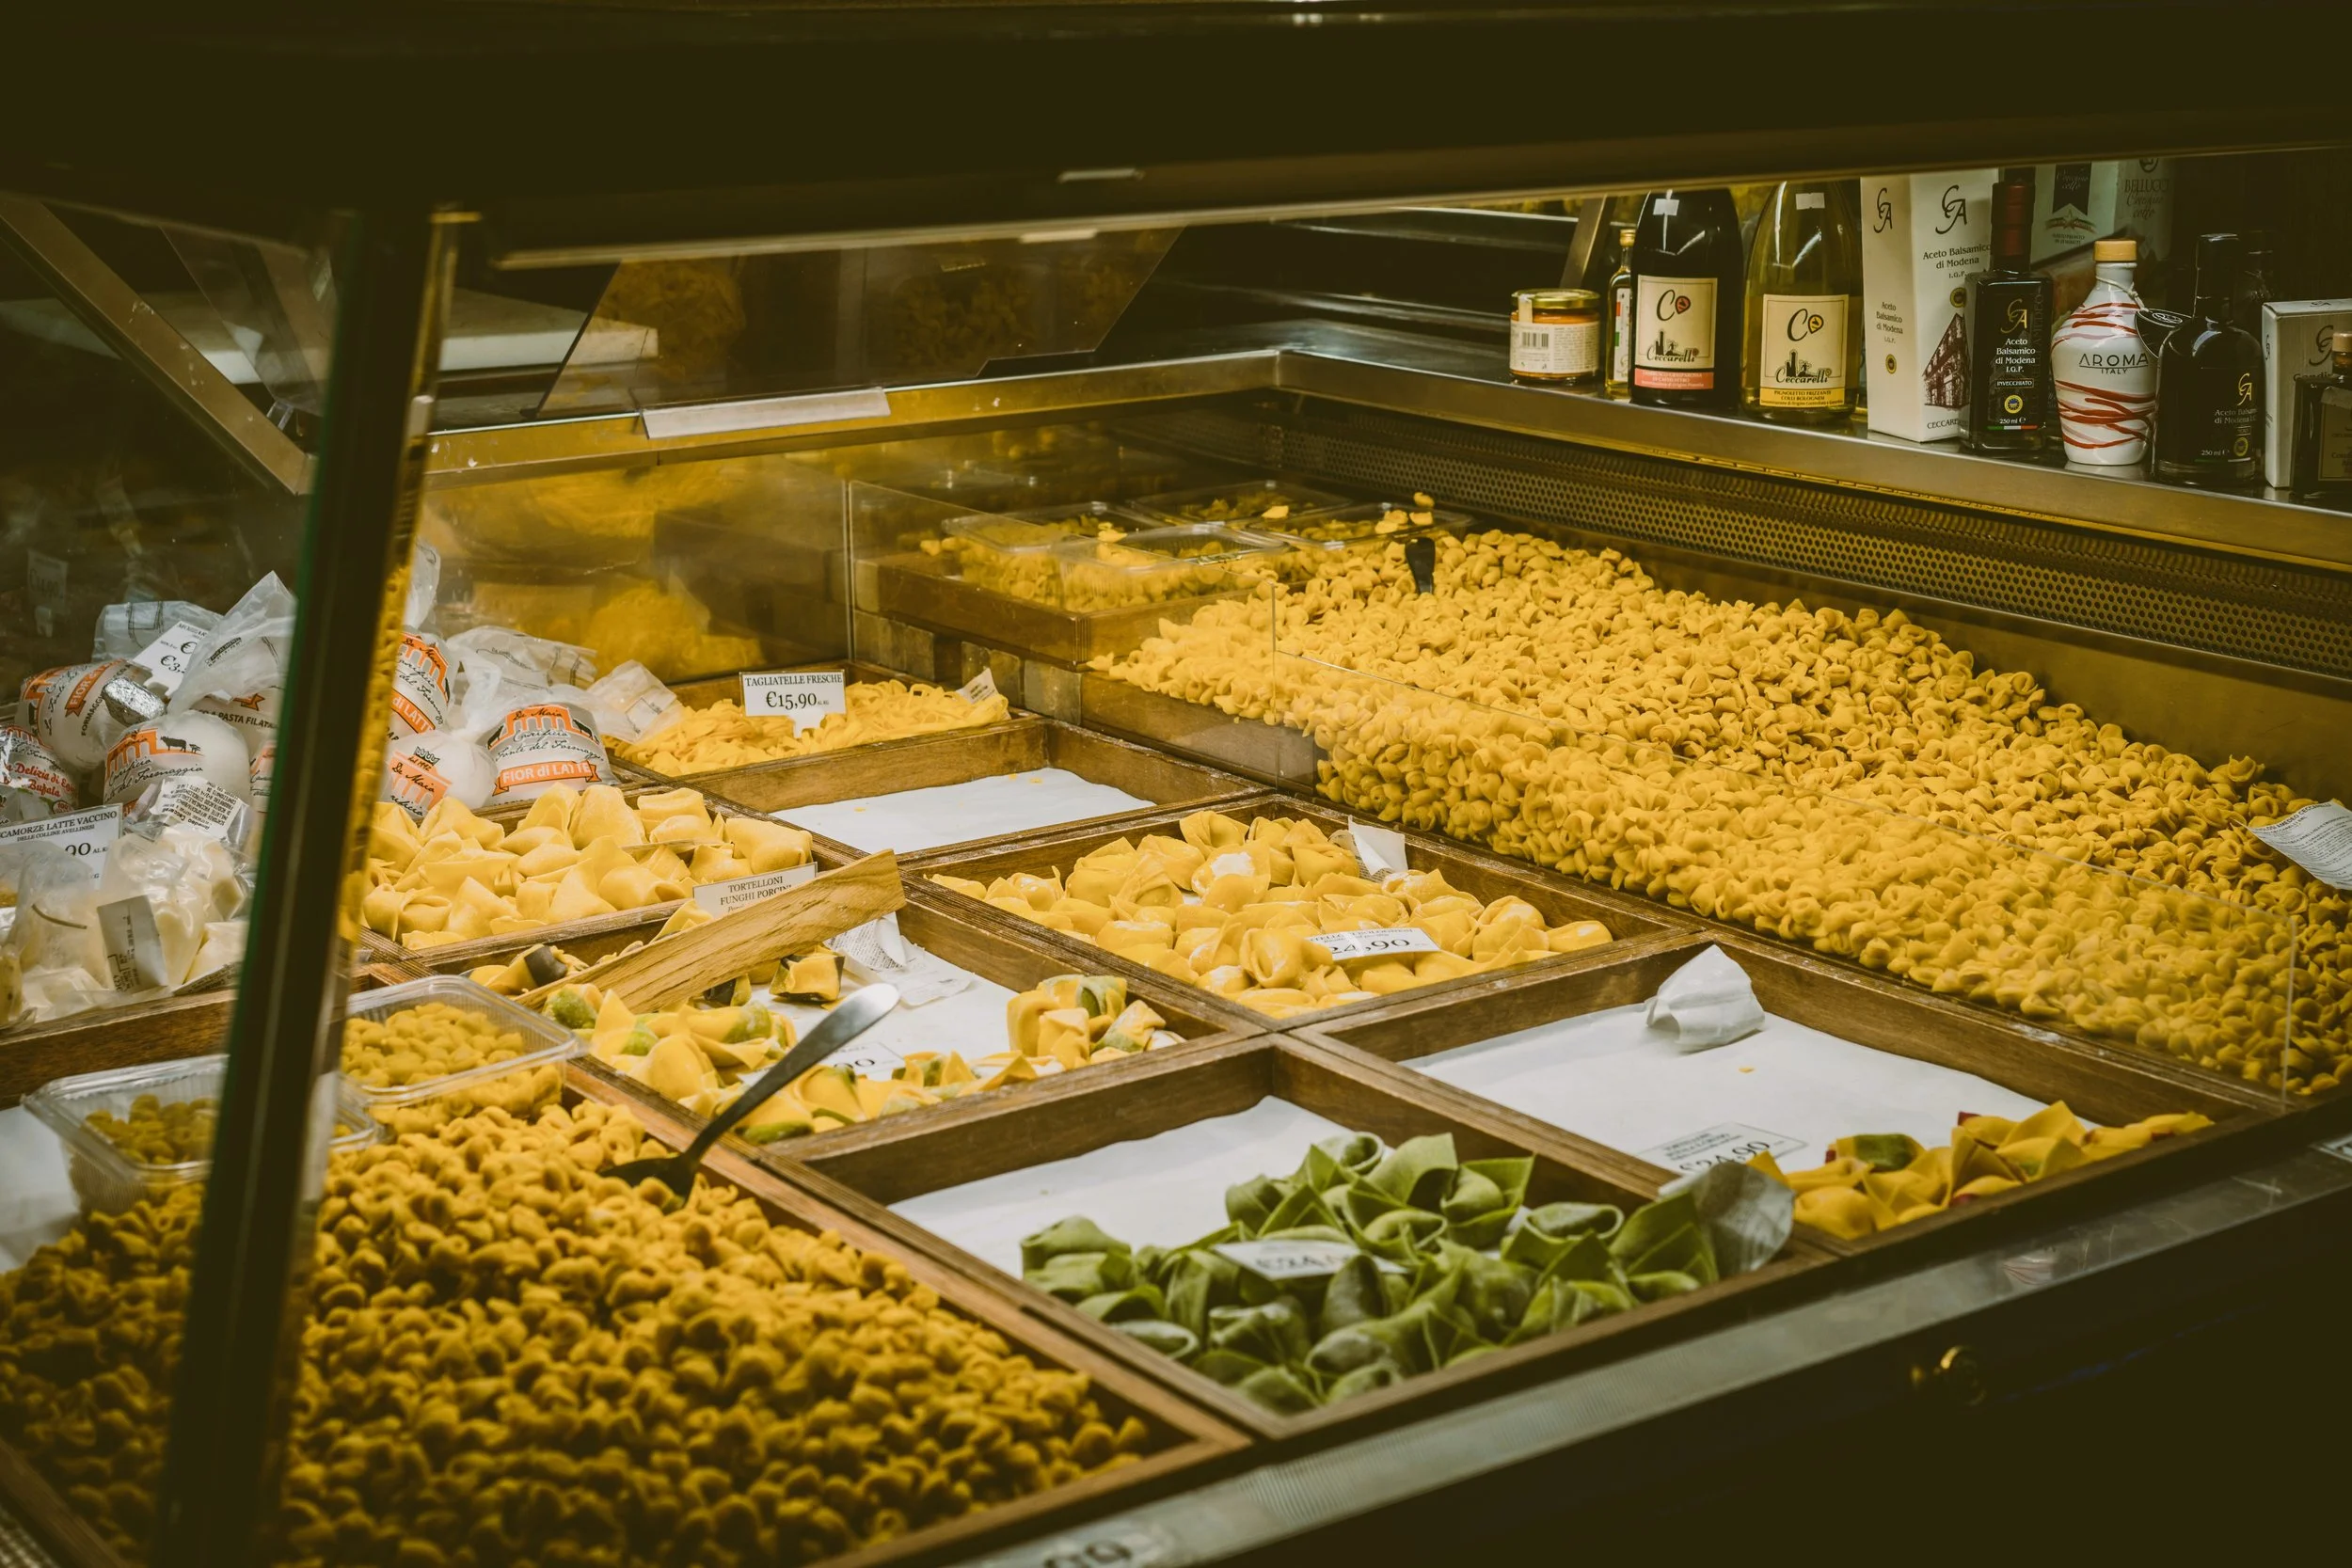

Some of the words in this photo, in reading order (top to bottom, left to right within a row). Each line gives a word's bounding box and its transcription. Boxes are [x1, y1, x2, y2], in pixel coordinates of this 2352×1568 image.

[1923, 250, 1947, 260] Aceto
[1949, 244, 1991, 256] Balsamico
[1936, 261, 1944, 269] di
[1947, 258, 1979, 267] Modena
[1882, 302, 1896, 310] Aceto
[2079, 353, 2149, 366] AROMA
[745, 675, 805, 687] TAGLIATELLE
[807, 673, 843, 683] FRESCHE
[69, 679, 91, 705] FIOR
[766, 690, 817, 710] €15,90
[404, 706, 432, 732] LATT
[15, 762, 50, 781] Delizia
[502, 768, 535, 784] FIOR
[537, 766, 550, 780] di
[552, 762, 591, 777] LATTE
[405, 774, 435, 793] Maio
[0, 824, 45, 838] CAMORZE
[46, 818, 75, 831] LATTE
[76, 810, 118, 826] VACCINO
[17, 833, 35, 842] DELLE
[35, 830, 61, 839] COLLINE
[728, 876, 783, 893] TORTELLONI
[721, 891, 755, 905] FUNGHI
[757, 884, 792, 898] PORCI
